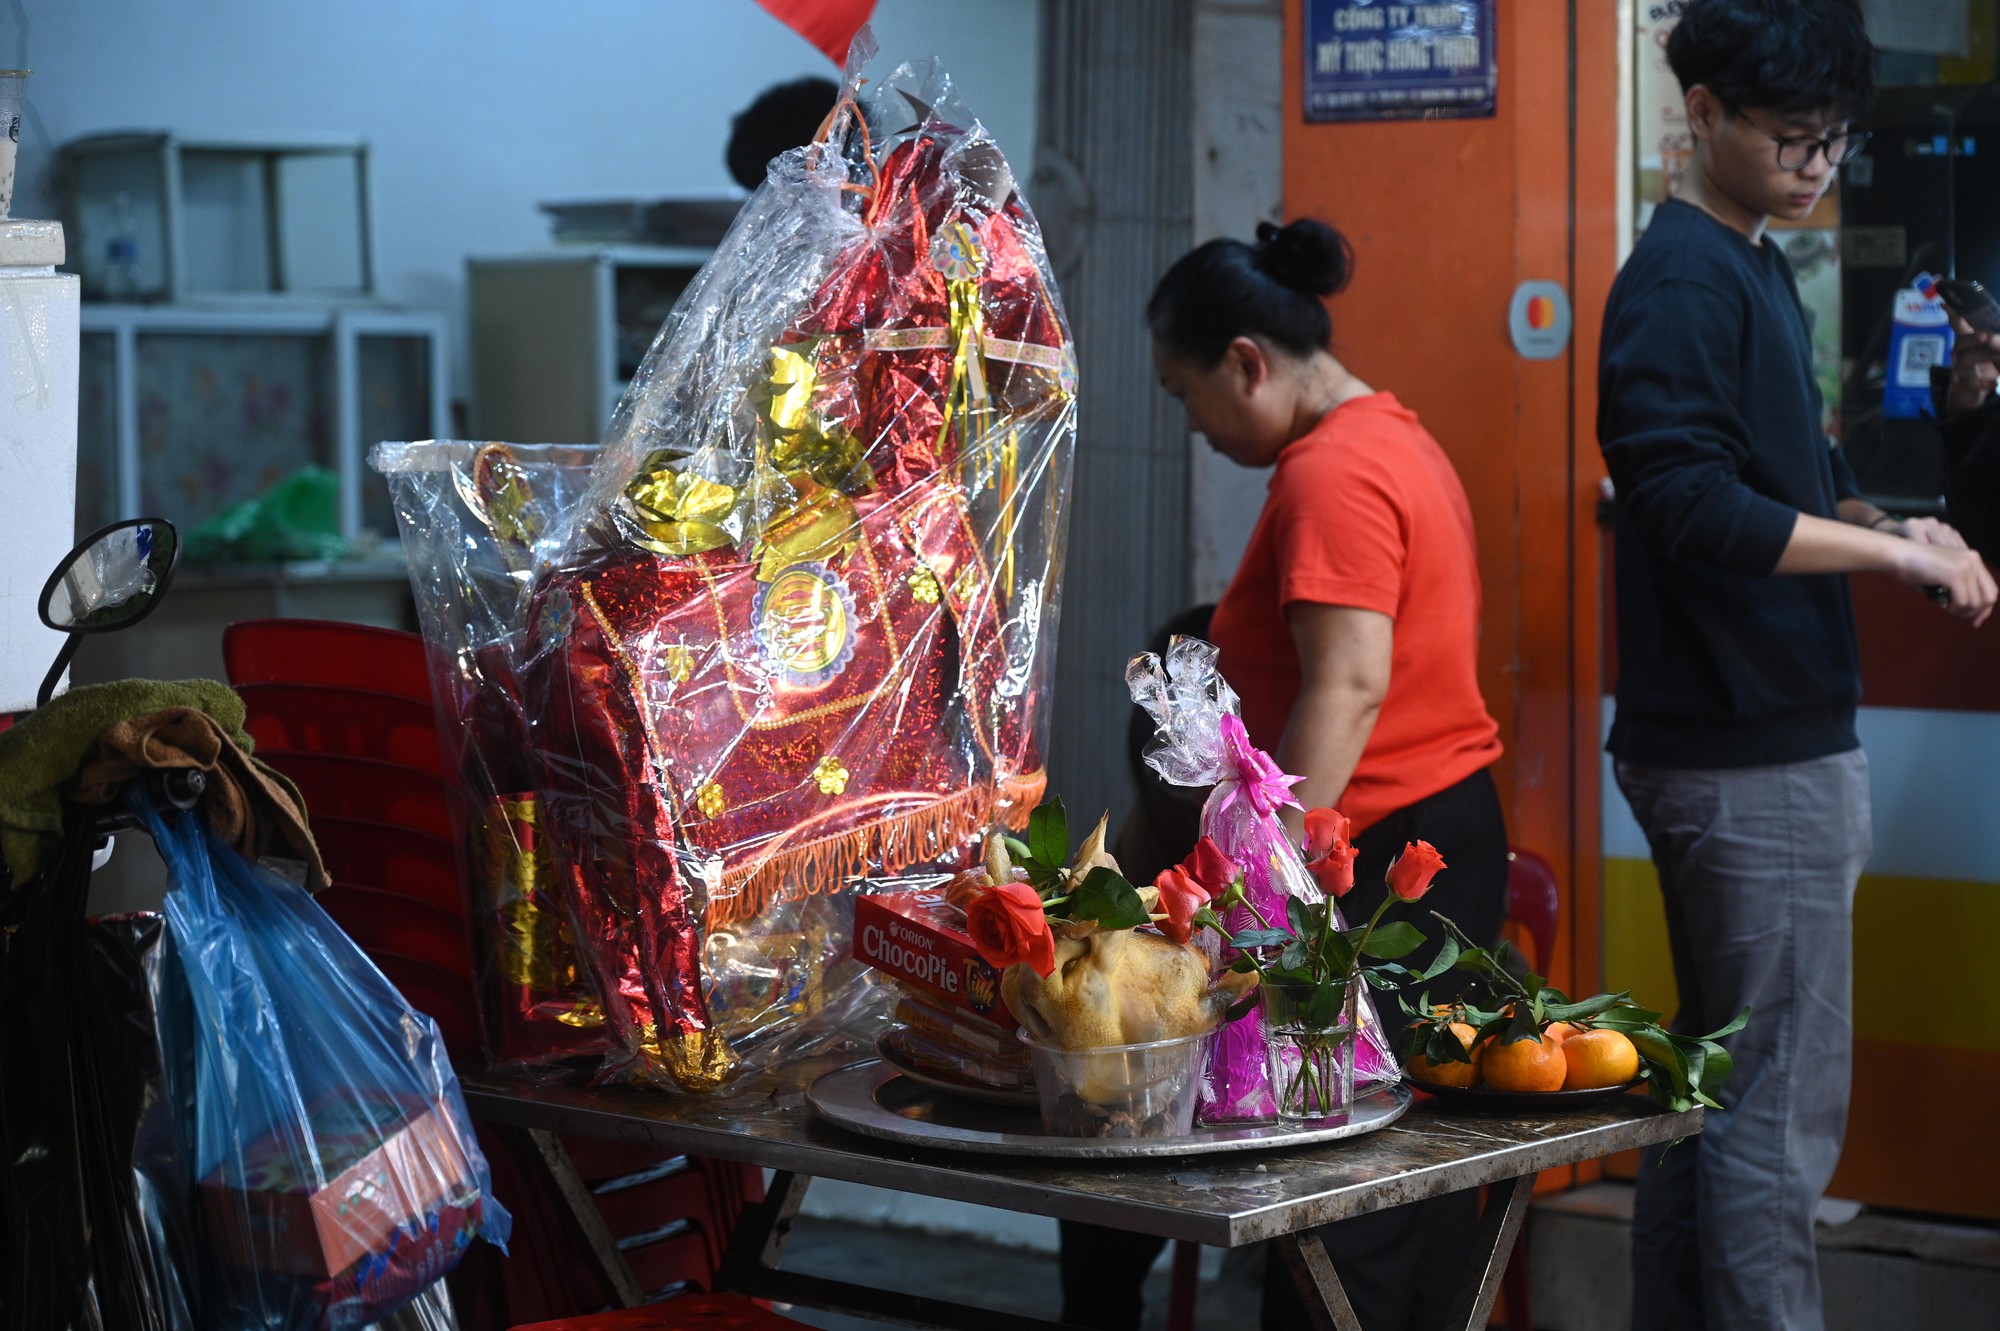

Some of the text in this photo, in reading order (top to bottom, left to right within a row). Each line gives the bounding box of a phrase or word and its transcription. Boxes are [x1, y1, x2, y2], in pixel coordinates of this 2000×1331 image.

[1387, 5, 1410, 28] TY
[900, 927, 933, 951] ORION
[863, 925, 958, 993] ChocoPie
